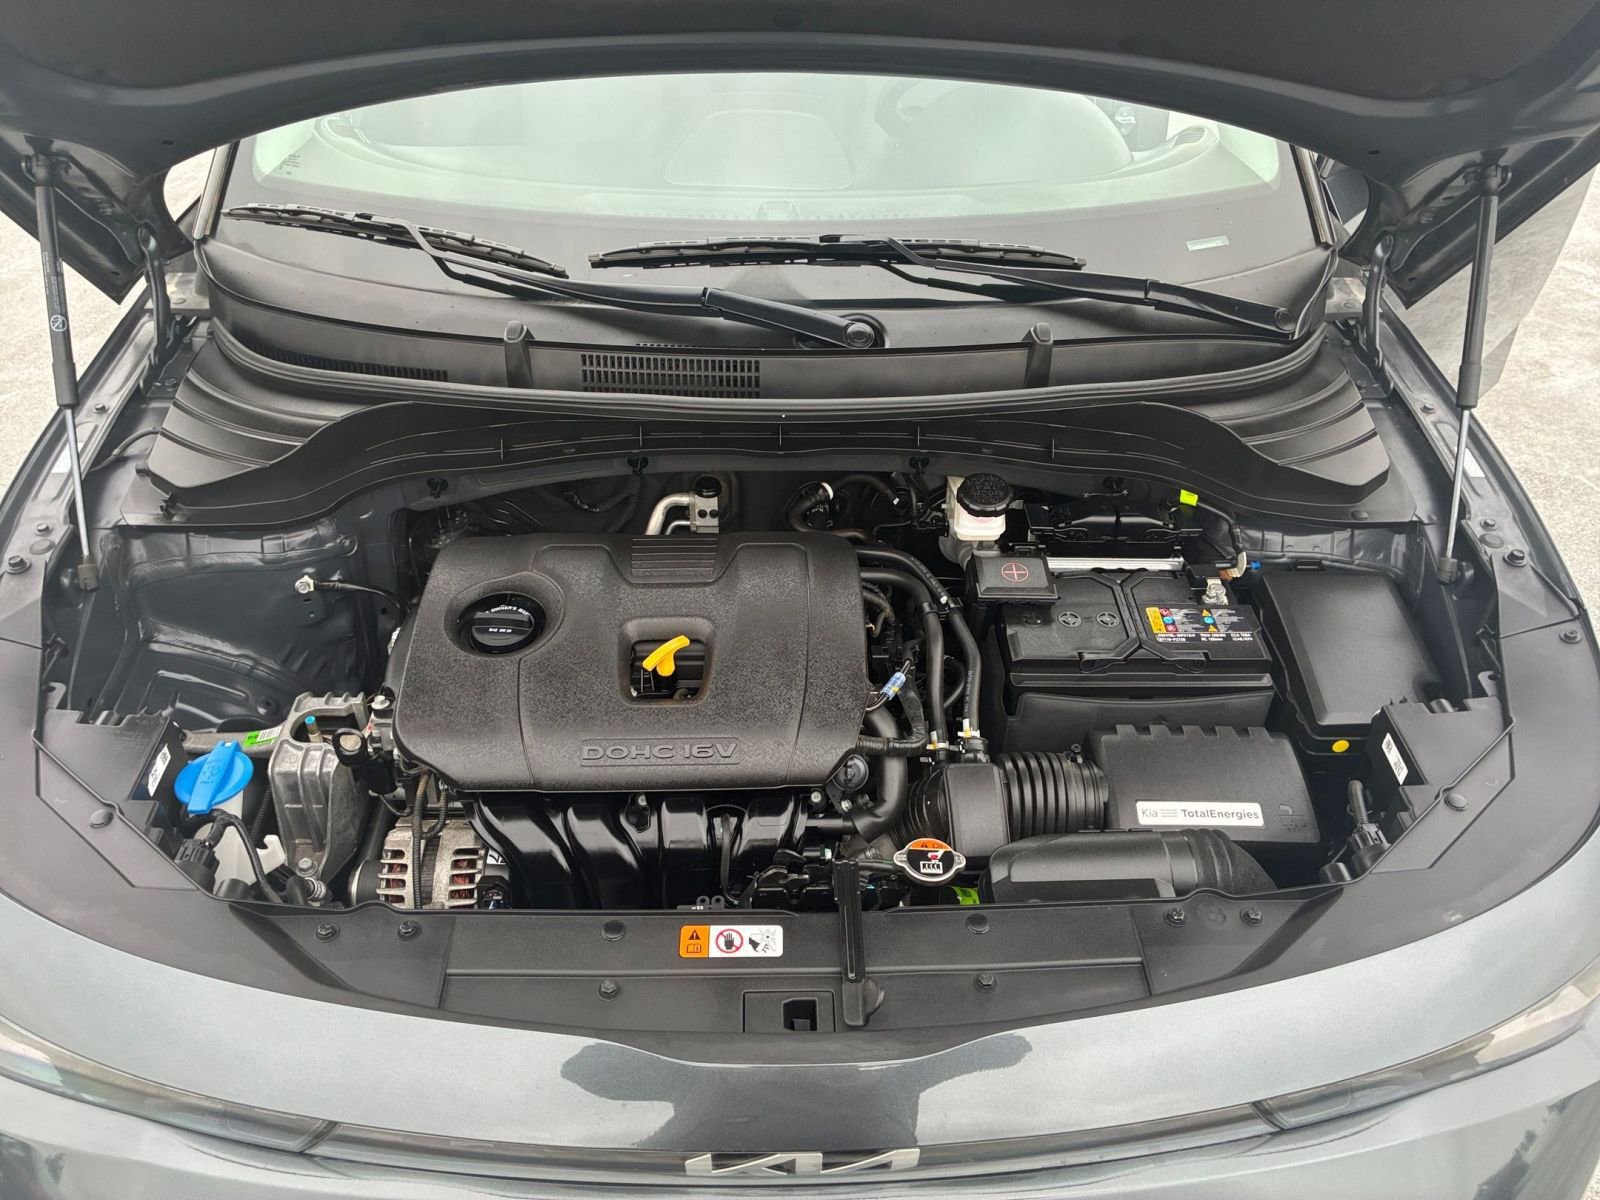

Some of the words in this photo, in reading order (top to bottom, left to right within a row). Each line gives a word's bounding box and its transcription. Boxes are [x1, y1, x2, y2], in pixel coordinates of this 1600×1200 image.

[581, 743, 676, 761] DOHC
[683, 742, 738, 759] 16V
[1141, 808, 1158, 818] Kia
[1181, 808, 1260, 820] TotalEnergies
